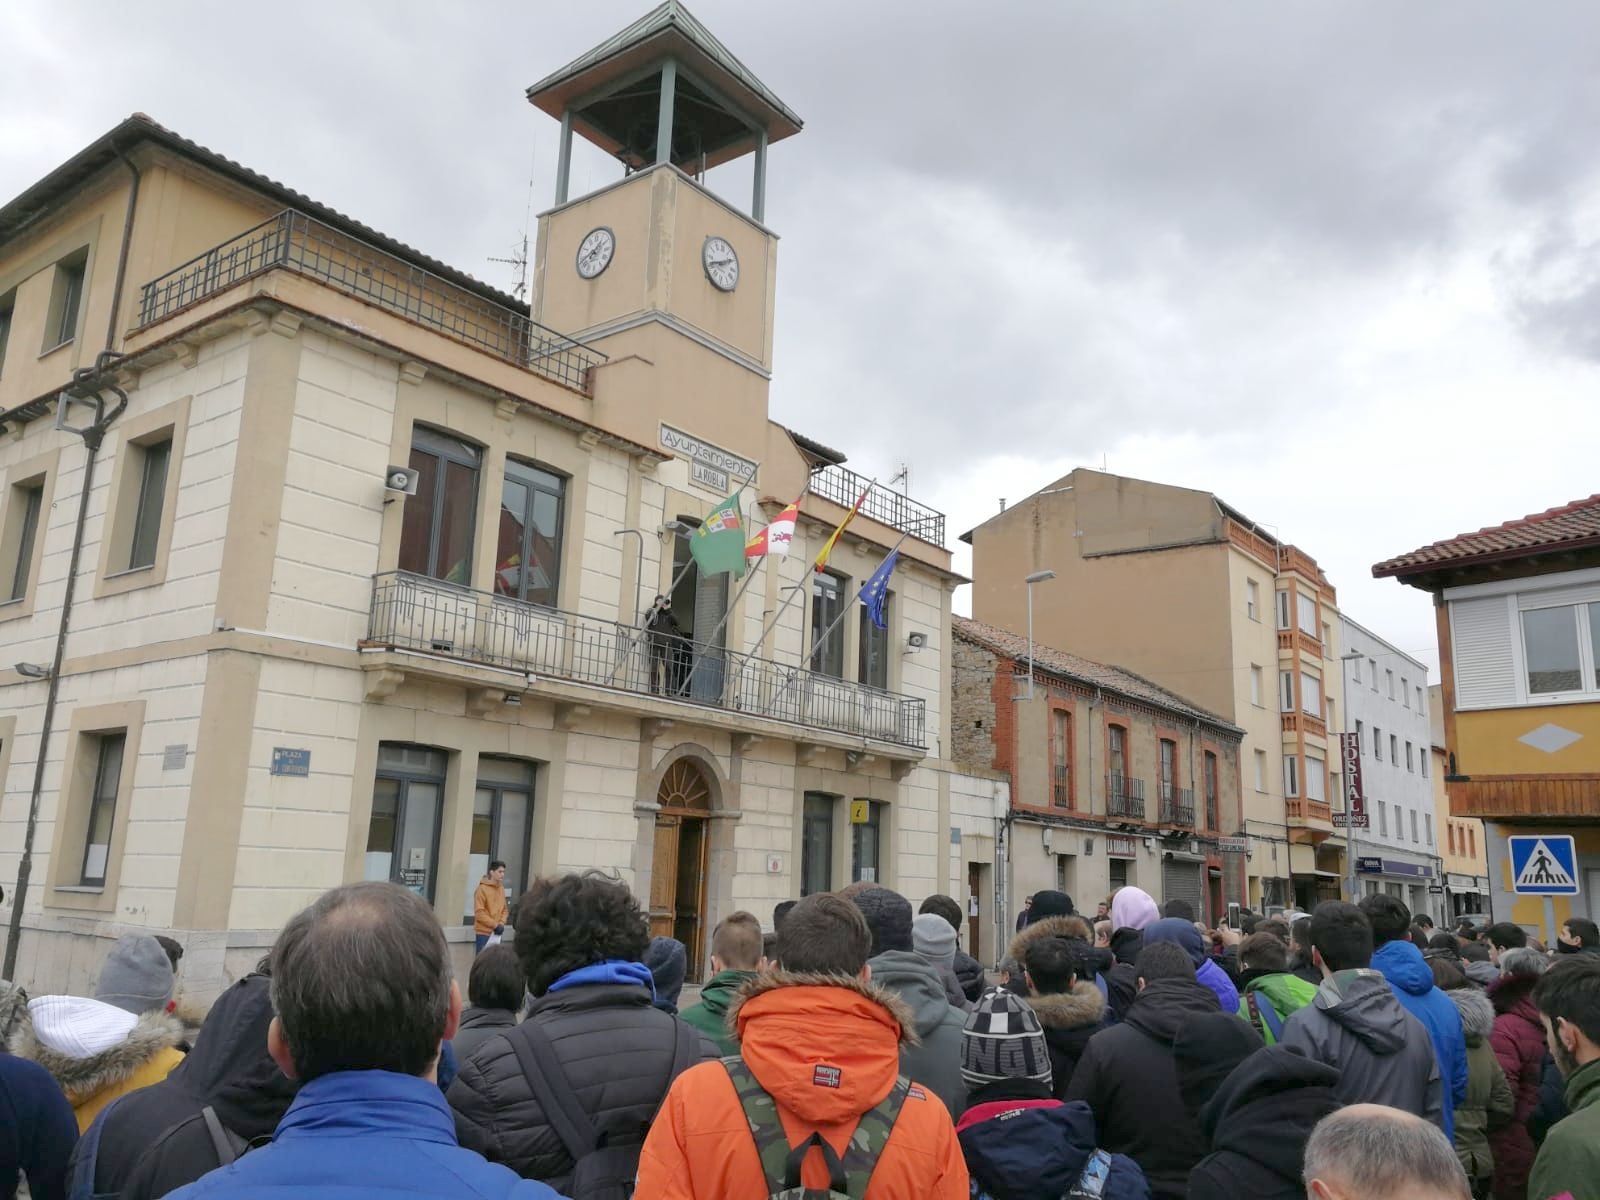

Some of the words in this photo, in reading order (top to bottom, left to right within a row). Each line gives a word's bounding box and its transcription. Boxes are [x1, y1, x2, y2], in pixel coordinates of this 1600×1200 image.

[664, 431, 753, 478] Ayuntamiento
[693, 462, 703, 480] LA
[703, 468, 725, 489] ROBLA
[1343, 734, 1361, 812] HOSTAL
